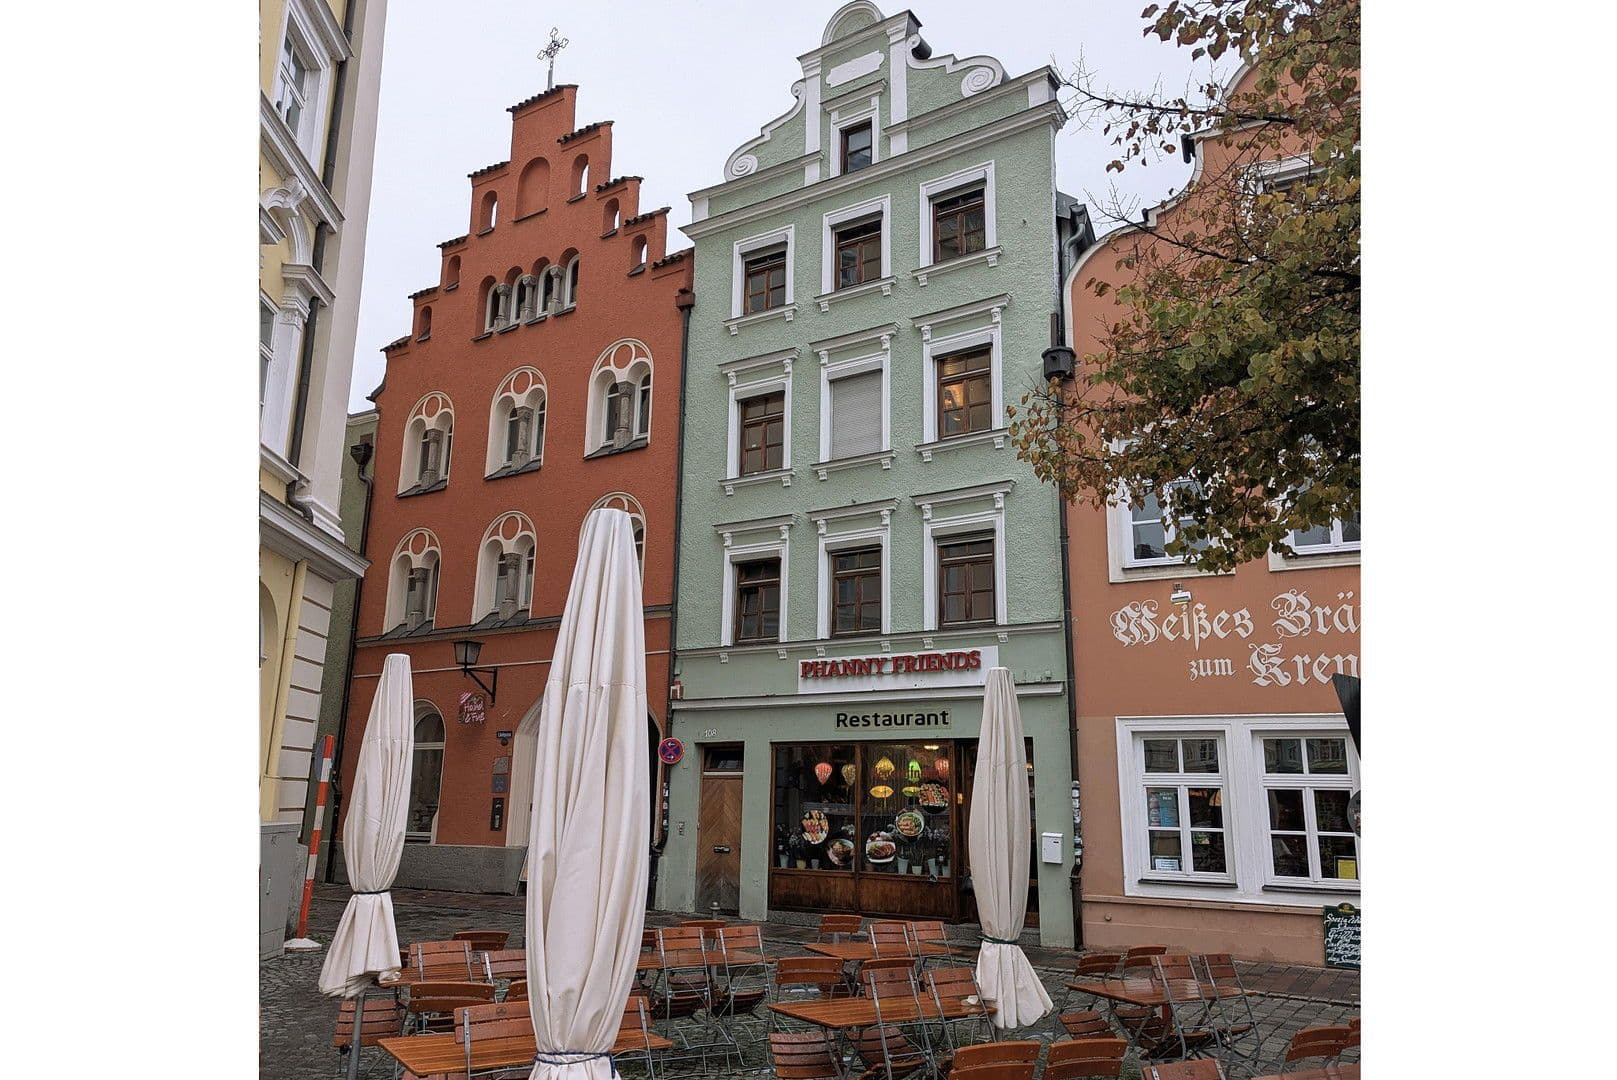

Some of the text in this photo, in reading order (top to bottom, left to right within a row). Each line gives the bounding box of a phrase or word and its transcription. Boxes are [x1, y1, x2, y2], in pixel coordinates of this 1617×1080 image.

[1110, 600, 1255, 651] Weißes
[800, 650, 981, 679] PHANNY FRIENDS
[1188, 658, 1237, 681] zum
[836, 710, 949, 728] Restaurant
